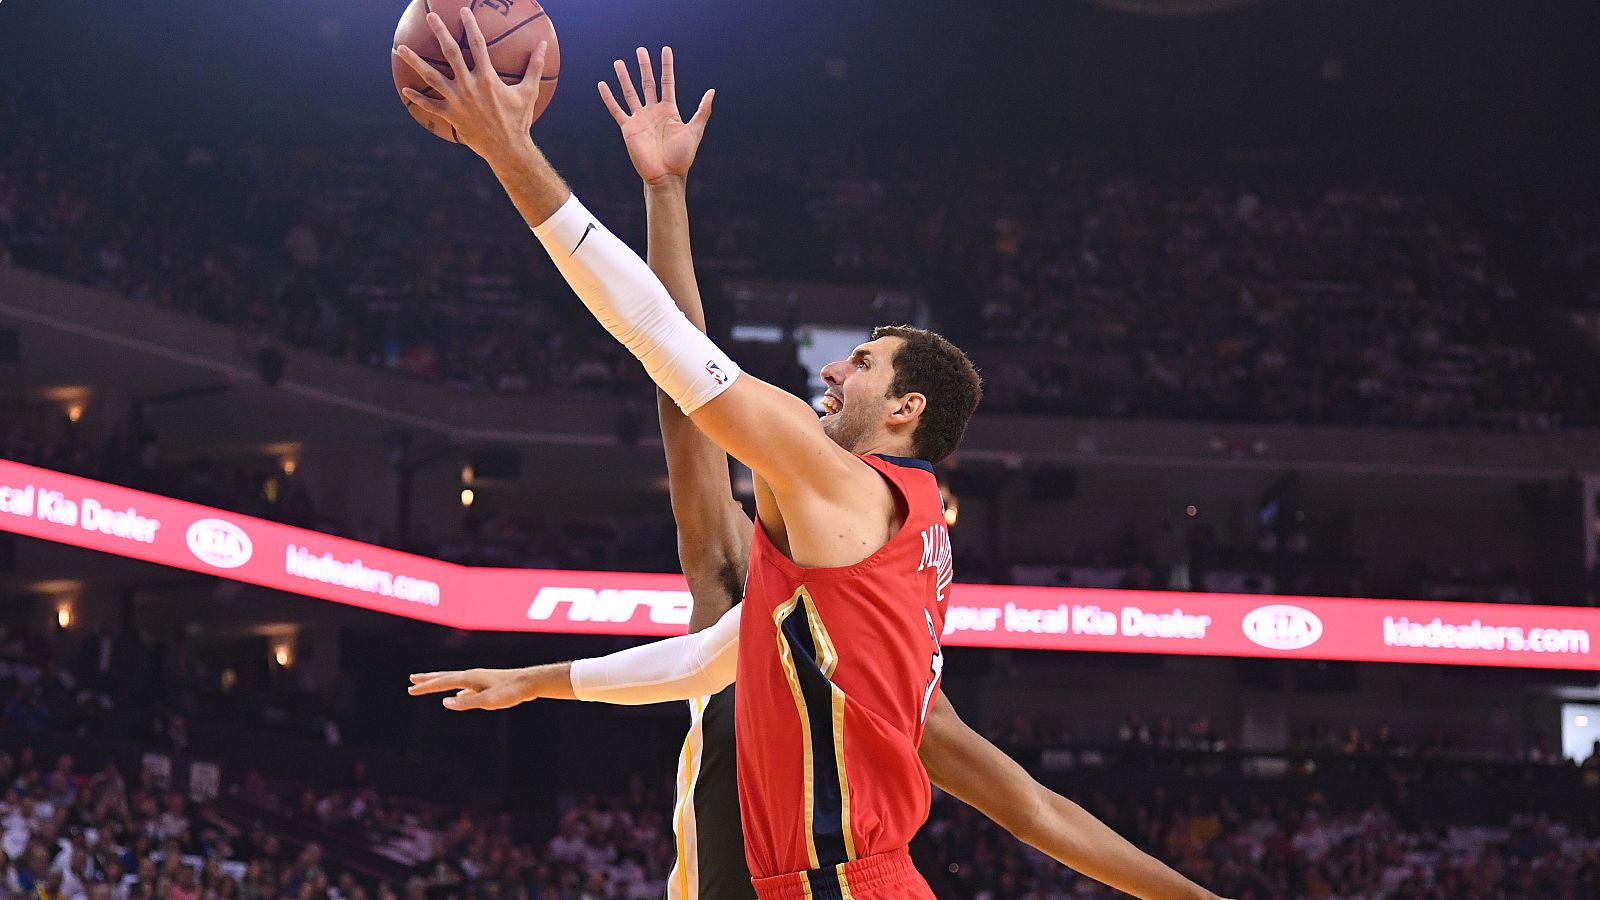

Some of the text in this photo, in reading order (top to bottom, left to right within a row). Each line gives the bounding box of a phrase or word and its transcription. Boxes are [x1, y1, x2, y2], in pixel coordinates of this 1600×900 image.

[36, 487, 79, 527] Kia
[80, 497, 161, 544] Dealer
[286, 543, 441, 607] kiadealers.com
[1004, 602, 1069, 634] local
[1071, 604, 1118, 636] Kia
[1120, 606, 1212, 639] Dealer
[1383, 615, 1590, 654] kiadealers.com
